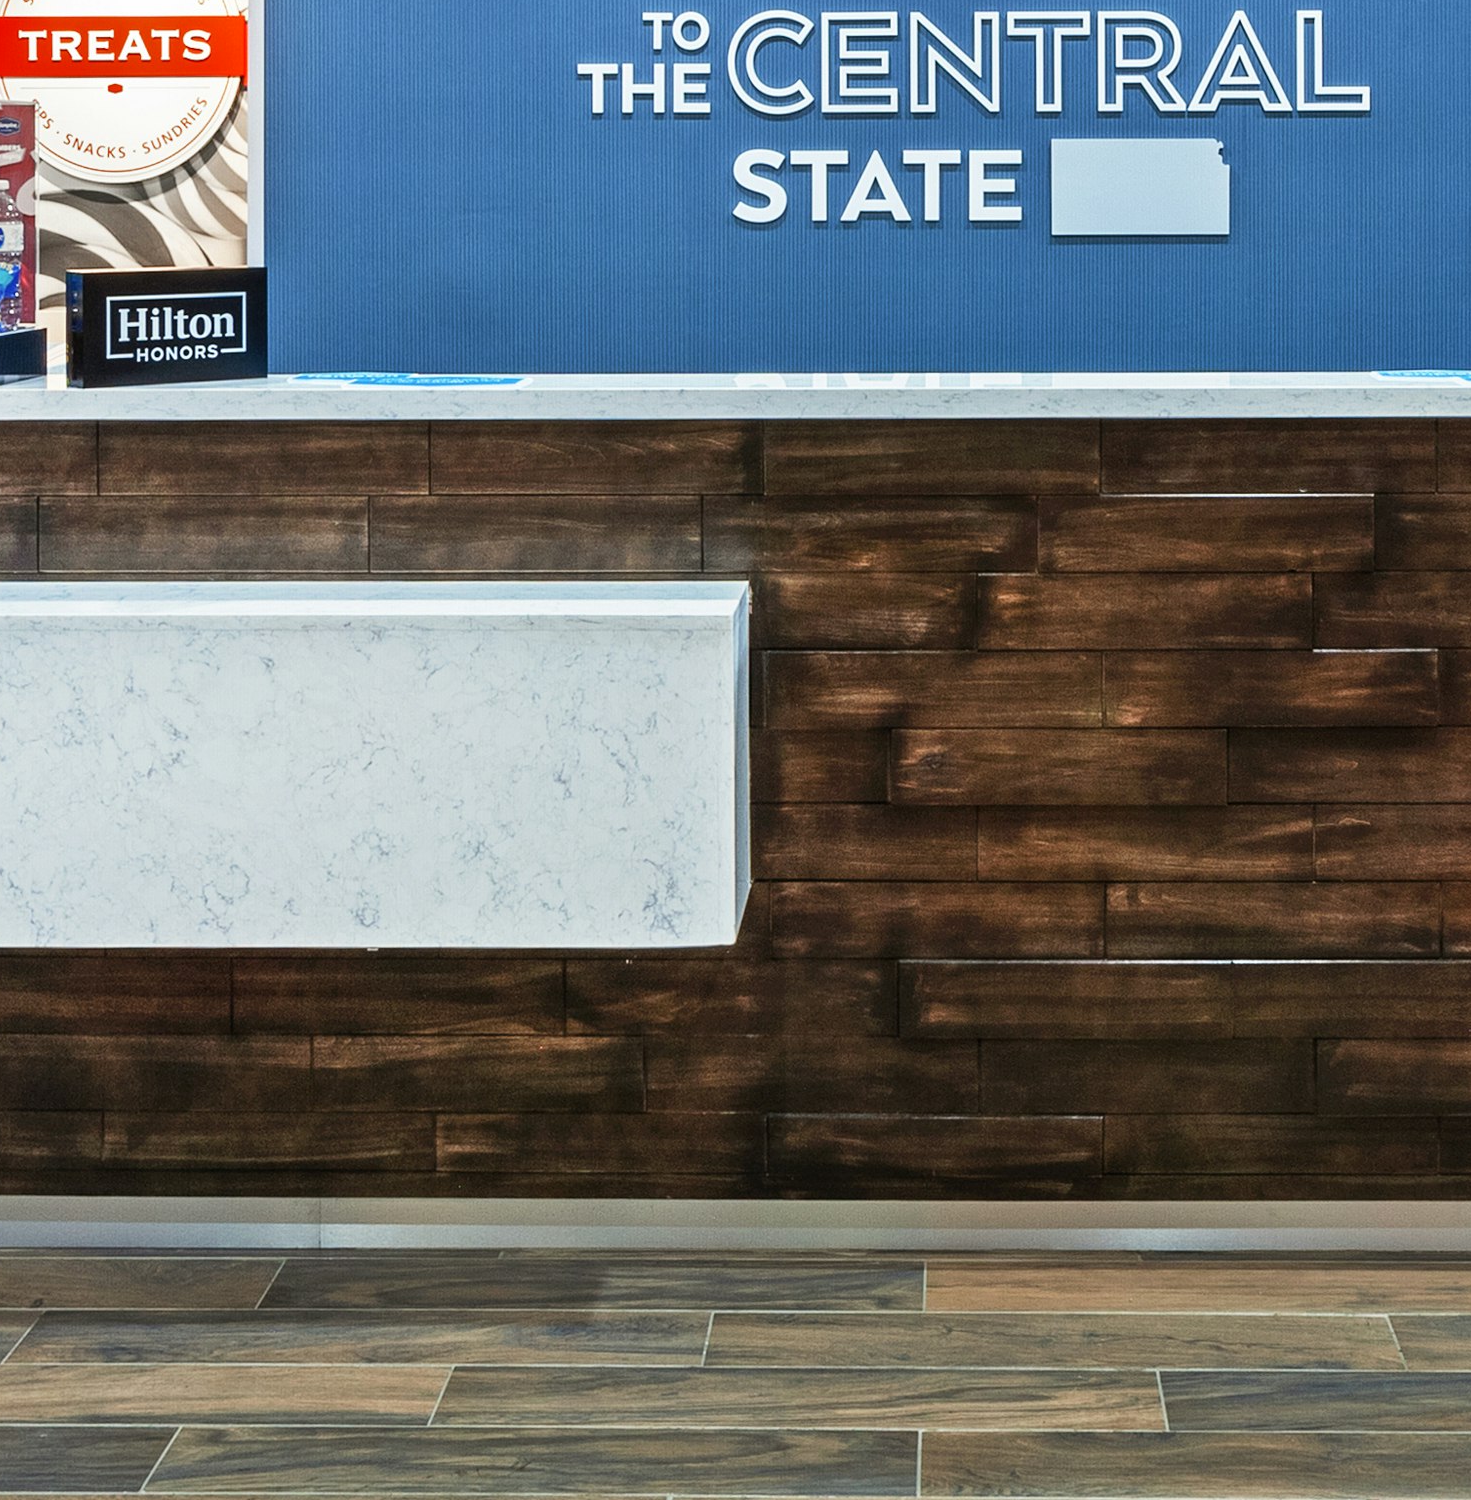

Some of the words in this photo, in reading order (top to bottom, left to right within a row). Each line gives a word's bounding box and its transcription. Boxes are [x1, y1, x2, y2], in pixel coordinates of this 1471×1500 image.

[18, 29, 212, 61] TREATS
[642, 11, 711, 51] TO
[577, 63, 713, 115] THE
[727, 9, 1371, 114] CENTRAL
[63, 133, 126, 158] SNACKS
[141, 97, 208, 155] SUNDRIES
[732, 149, 1023, 224] STATE
[118, 307, 235, 342] Hilton
[136, 344, 218, 362] HONORS
